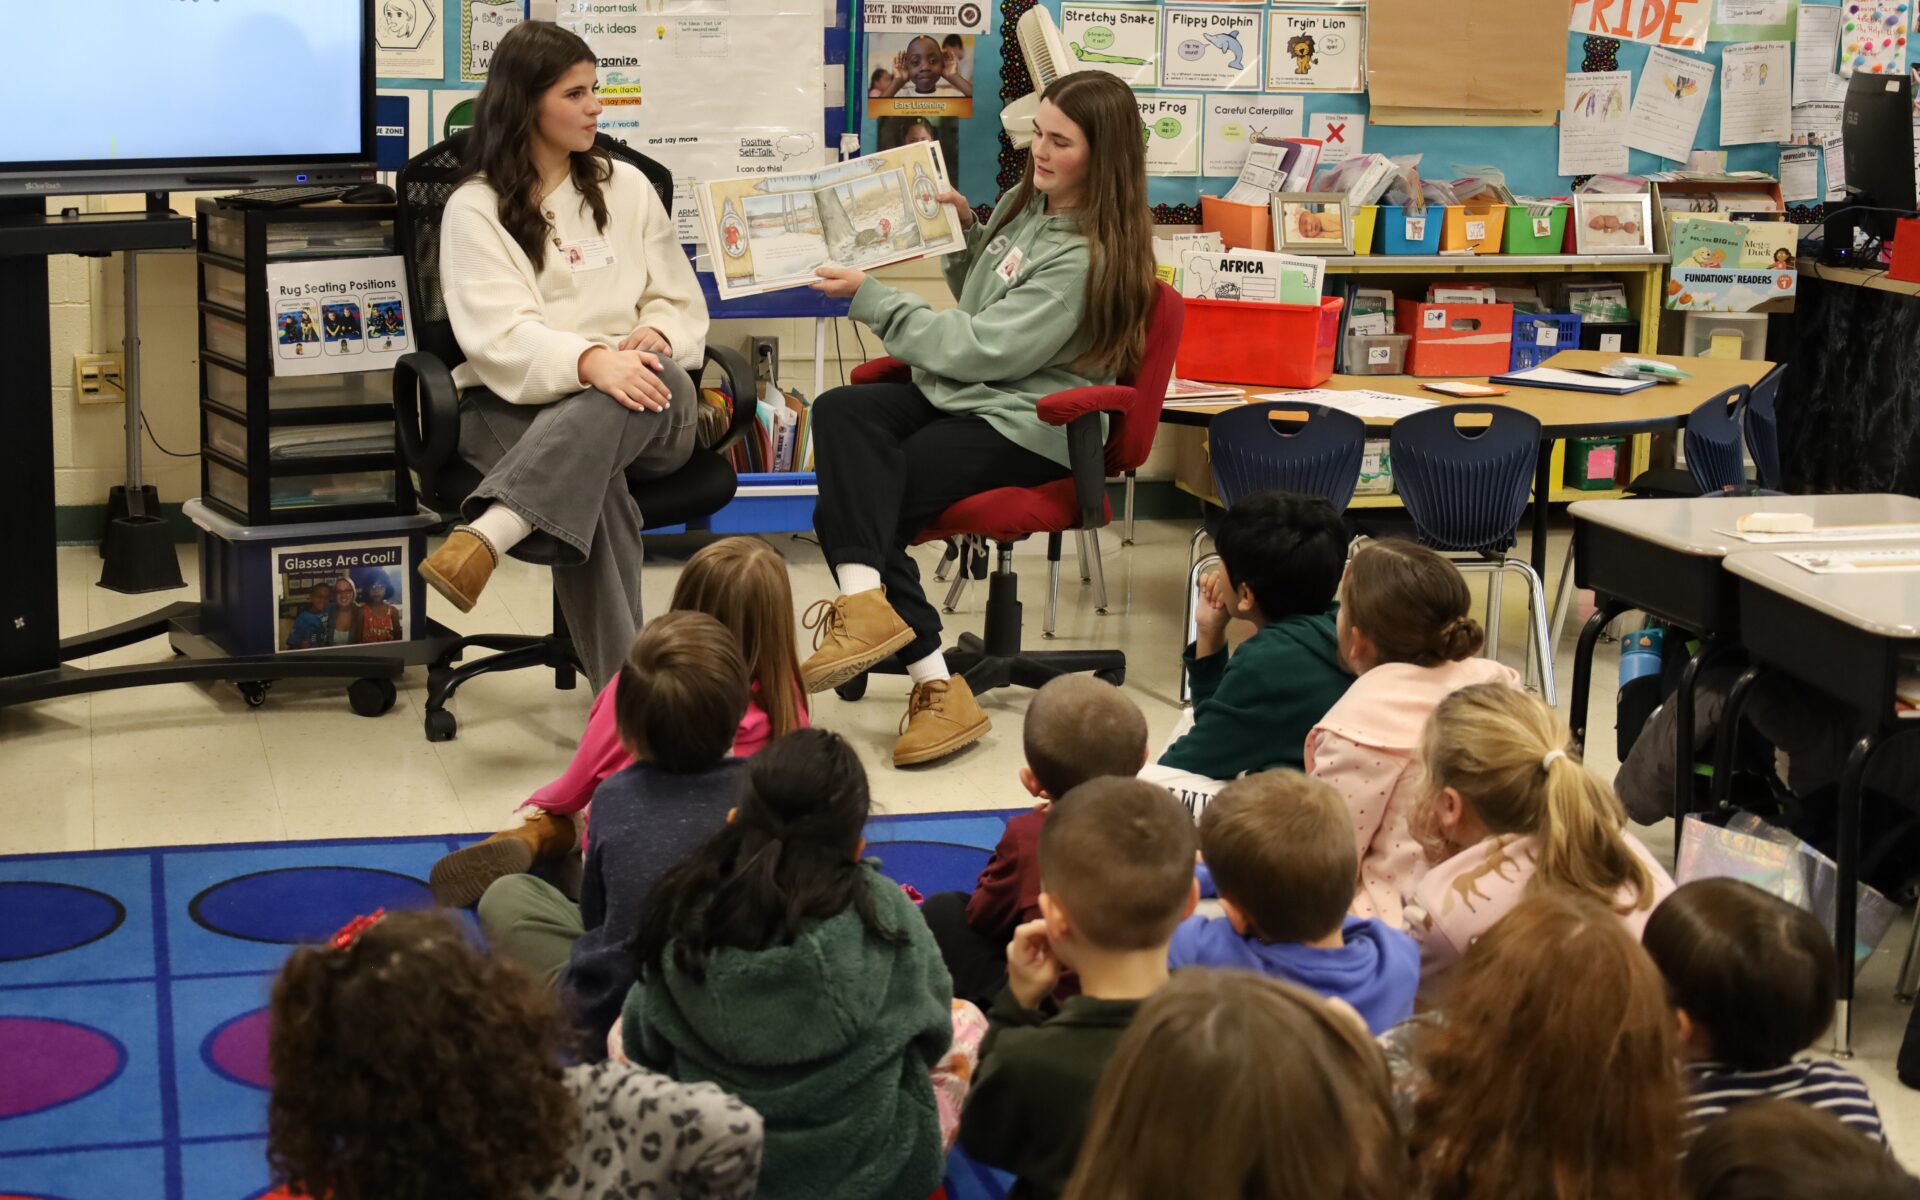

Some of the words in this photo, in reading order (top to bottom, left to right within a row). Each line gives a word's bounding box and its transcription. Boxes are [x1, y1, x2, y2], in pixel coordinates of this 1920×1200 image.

[594, 4, 616, 14] apart
[618, 3, 637, 13] task
[864, 4, 887, 14] PECT,
[891, 3, 957, 14] RESPONSIBILITY
[864, 15, 887, 25] AFETY
[891, 16, 902, 25] TO
[906, 16, 929, 25] SHOW
[933, 16, 957, 26] PRIDE
[1065, 10, 1116, 26] Stretchy
[1120, 13, 1155, 25] Snake
[1172, 14, 1208, 28] Flippy
[1211, 14, 1254, 28] Dolphin
[584, 23, 604, 34] Pick
[607, 23, 637, 34] ideas
[1287, 17, 1320, 31] Tryin'
[1322, 18, 1346, 29] Lion
[482, 41, 500, 51] BU
[596, 56, 638, 67] rganize
[620, 86, 641, 94] (facts)
[912, 100, 946, 112] Listening
[1159, 101, 1187, 115] Frog
[1215, 106, 1246, 115] Careful
[1248, 107, 1294, 117] Caterpillar
[741, 138, 772, 147] Positive
[739, 148, 775, 158] Self-Talk
[756, 165, 766, 173] do
[767, 165, 783, 173] this!
[1748, 249, 1771, 257] Duck
[1219, 259, 1264, 275] AFRICA
[1737, 275, 1772, 285] READERS
[1781, 281, 1787, 289] 1
[280, 285, 301, 297] Rug
[304, 281, 347, 294] Seating
[350, 279, 396, 291] Positions
[1428, 313, 1435, 321] D
[1545, 330, 1551, 339] E
[1608, 336, 1613, 345] F
[1371, 350, 1379, 359] C
[1365, 459, 1372, 467] H
[285, 557, 333, 571] Glasses
[336, 554, 359, 567] Are
[362, 550, 396, 564] Cool!
